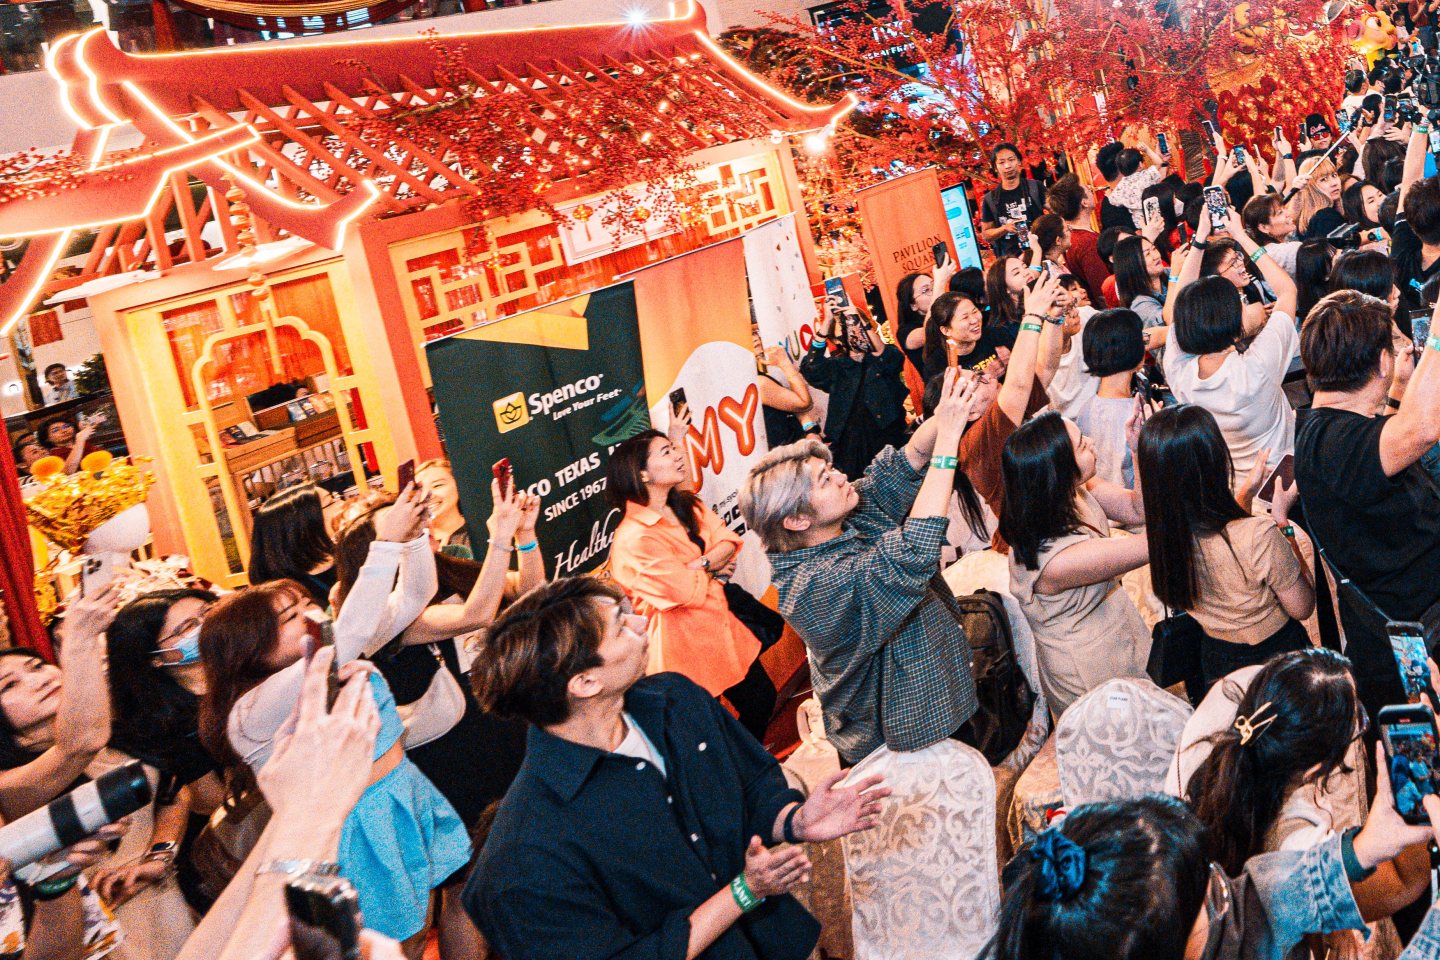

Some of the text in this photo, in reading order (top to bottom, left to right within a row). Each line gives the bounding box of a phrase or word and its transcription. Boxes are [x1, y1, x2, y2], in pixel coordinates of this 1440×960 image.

[893, 234, 941, 263] PAVILION
[902, 251, 937, 274] SQUAR
[528, 375, 601, 415] Spenco
[553, 388, 620, 420] Love Your Feet
[683, 383, 759, 494] MY
[555, 452, 601, 487] TEXAS
[544, 477, 607, 522] SINCE 1967
